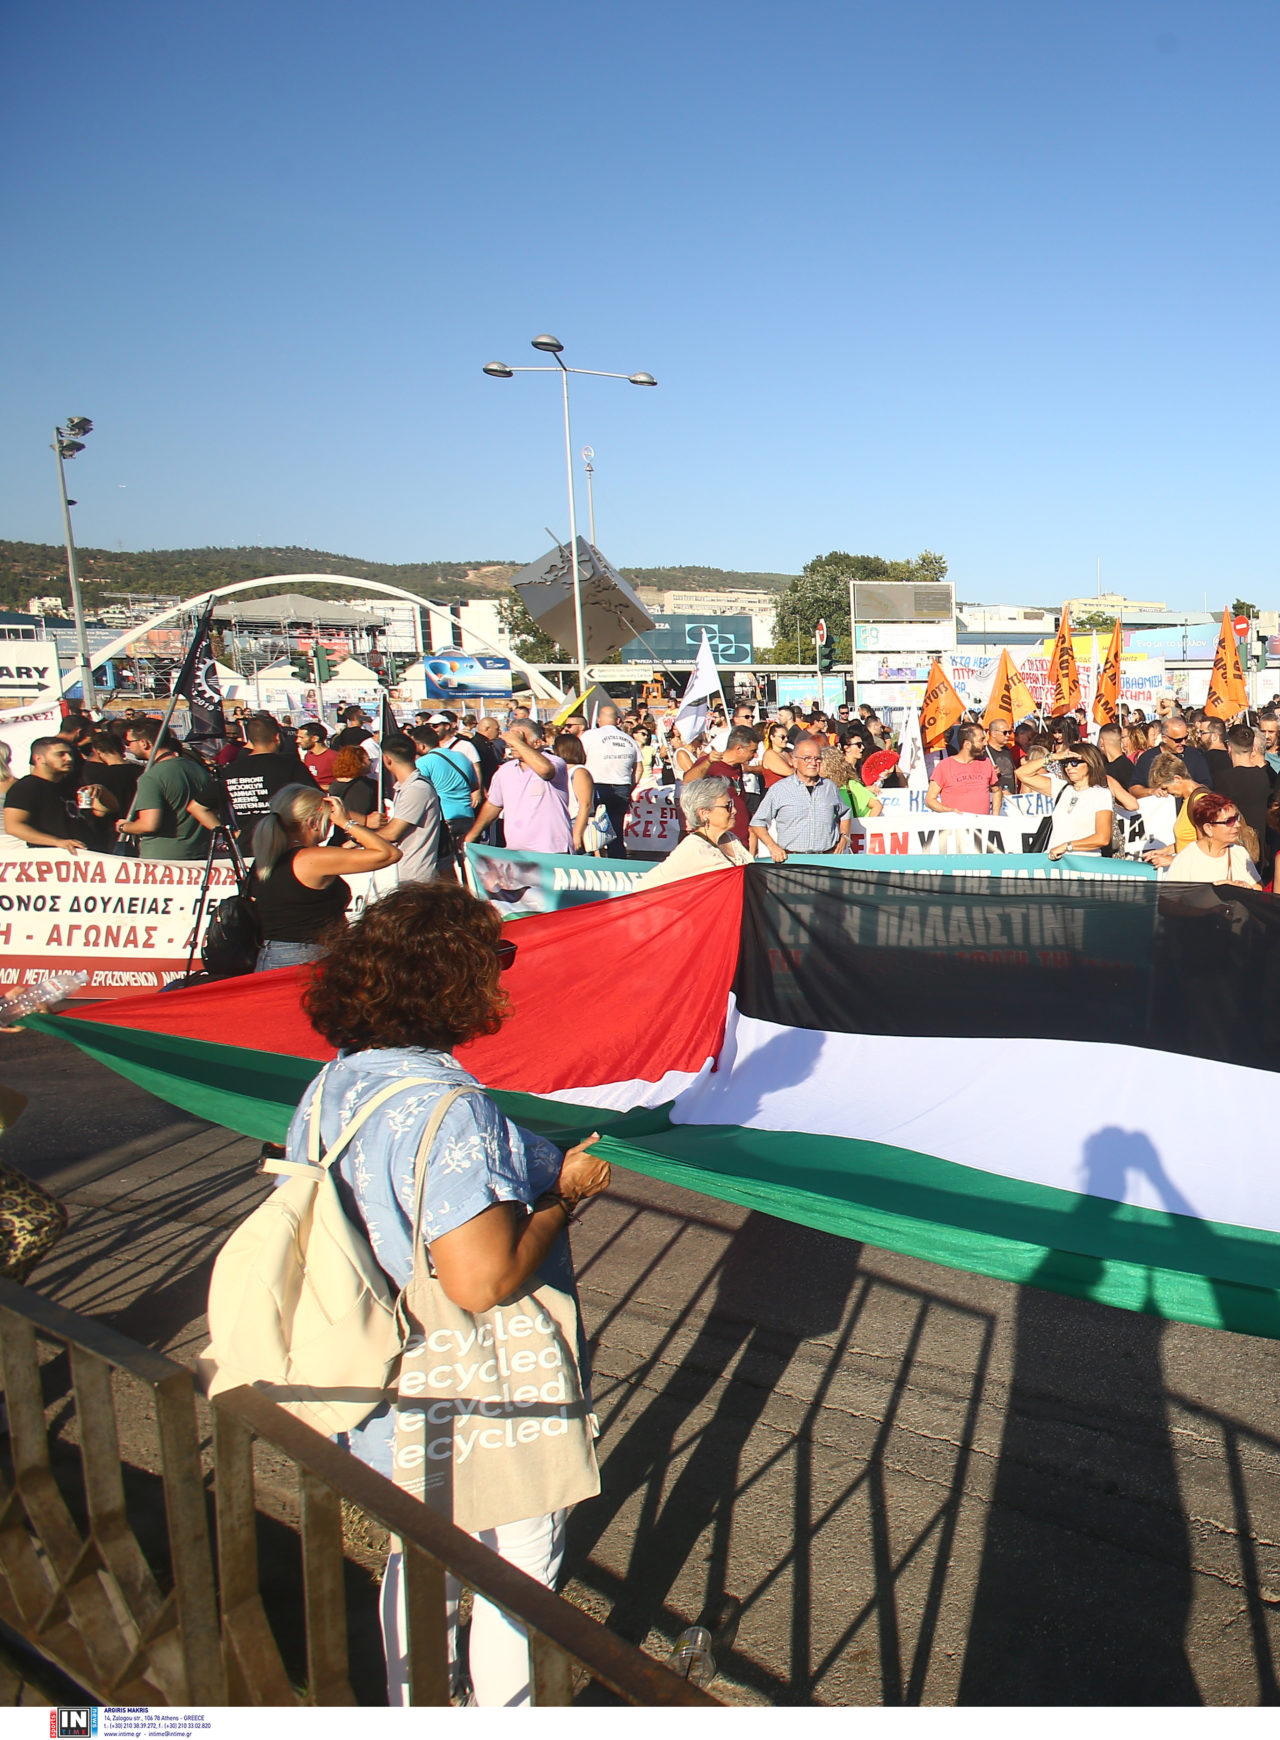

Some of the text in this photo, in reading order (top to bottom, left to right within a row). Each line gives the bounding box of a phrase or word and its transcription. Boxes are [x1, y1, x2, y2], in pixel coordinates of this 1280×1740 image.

[1177, 637, 1207, 650] μλλον
[0, 665, 49, 680] ARY
[192, 696, 215, 712] 2019
[0, 861, 238, 886] ΓΧΡΟΝΑ ΔΙΚΑΙΩΜΑ
[69, 896, 173, 915] ΔΟΥΛΕΙΑΣ
[46, 923, 159, 949] ΑΓΩΝΑΣ
[398, 1339, 563, 1396] ecycled
[394, 1372, 567, 1433] ecycled
[393, 1406, 569, 1470] ecycled
